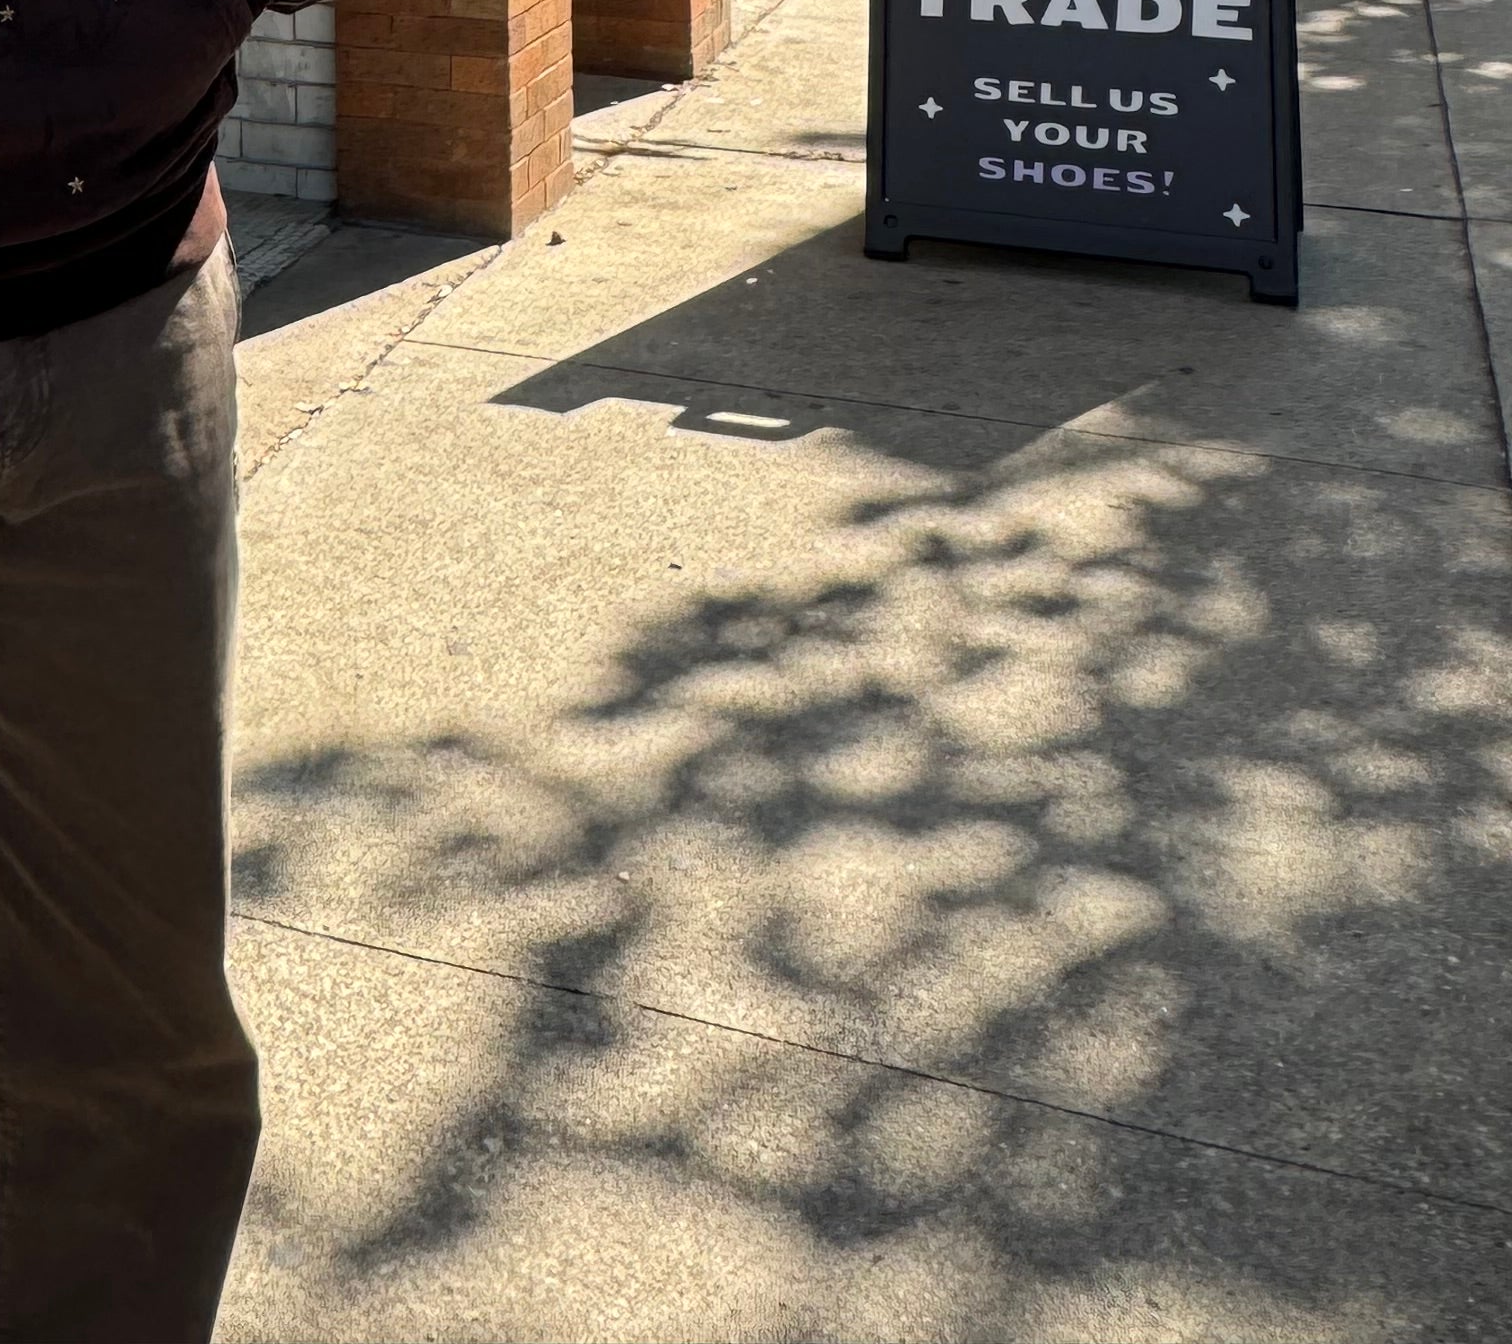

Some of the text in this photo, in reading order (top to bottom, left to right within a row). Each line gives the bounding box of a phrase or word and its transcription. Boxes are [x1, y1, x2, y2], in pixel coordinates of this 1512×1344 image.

[973, 77, 1179, 115] SELL US
[1003, 119, 1148, 154] YOUR
[978, 156, 1174, 196] SHOES!
